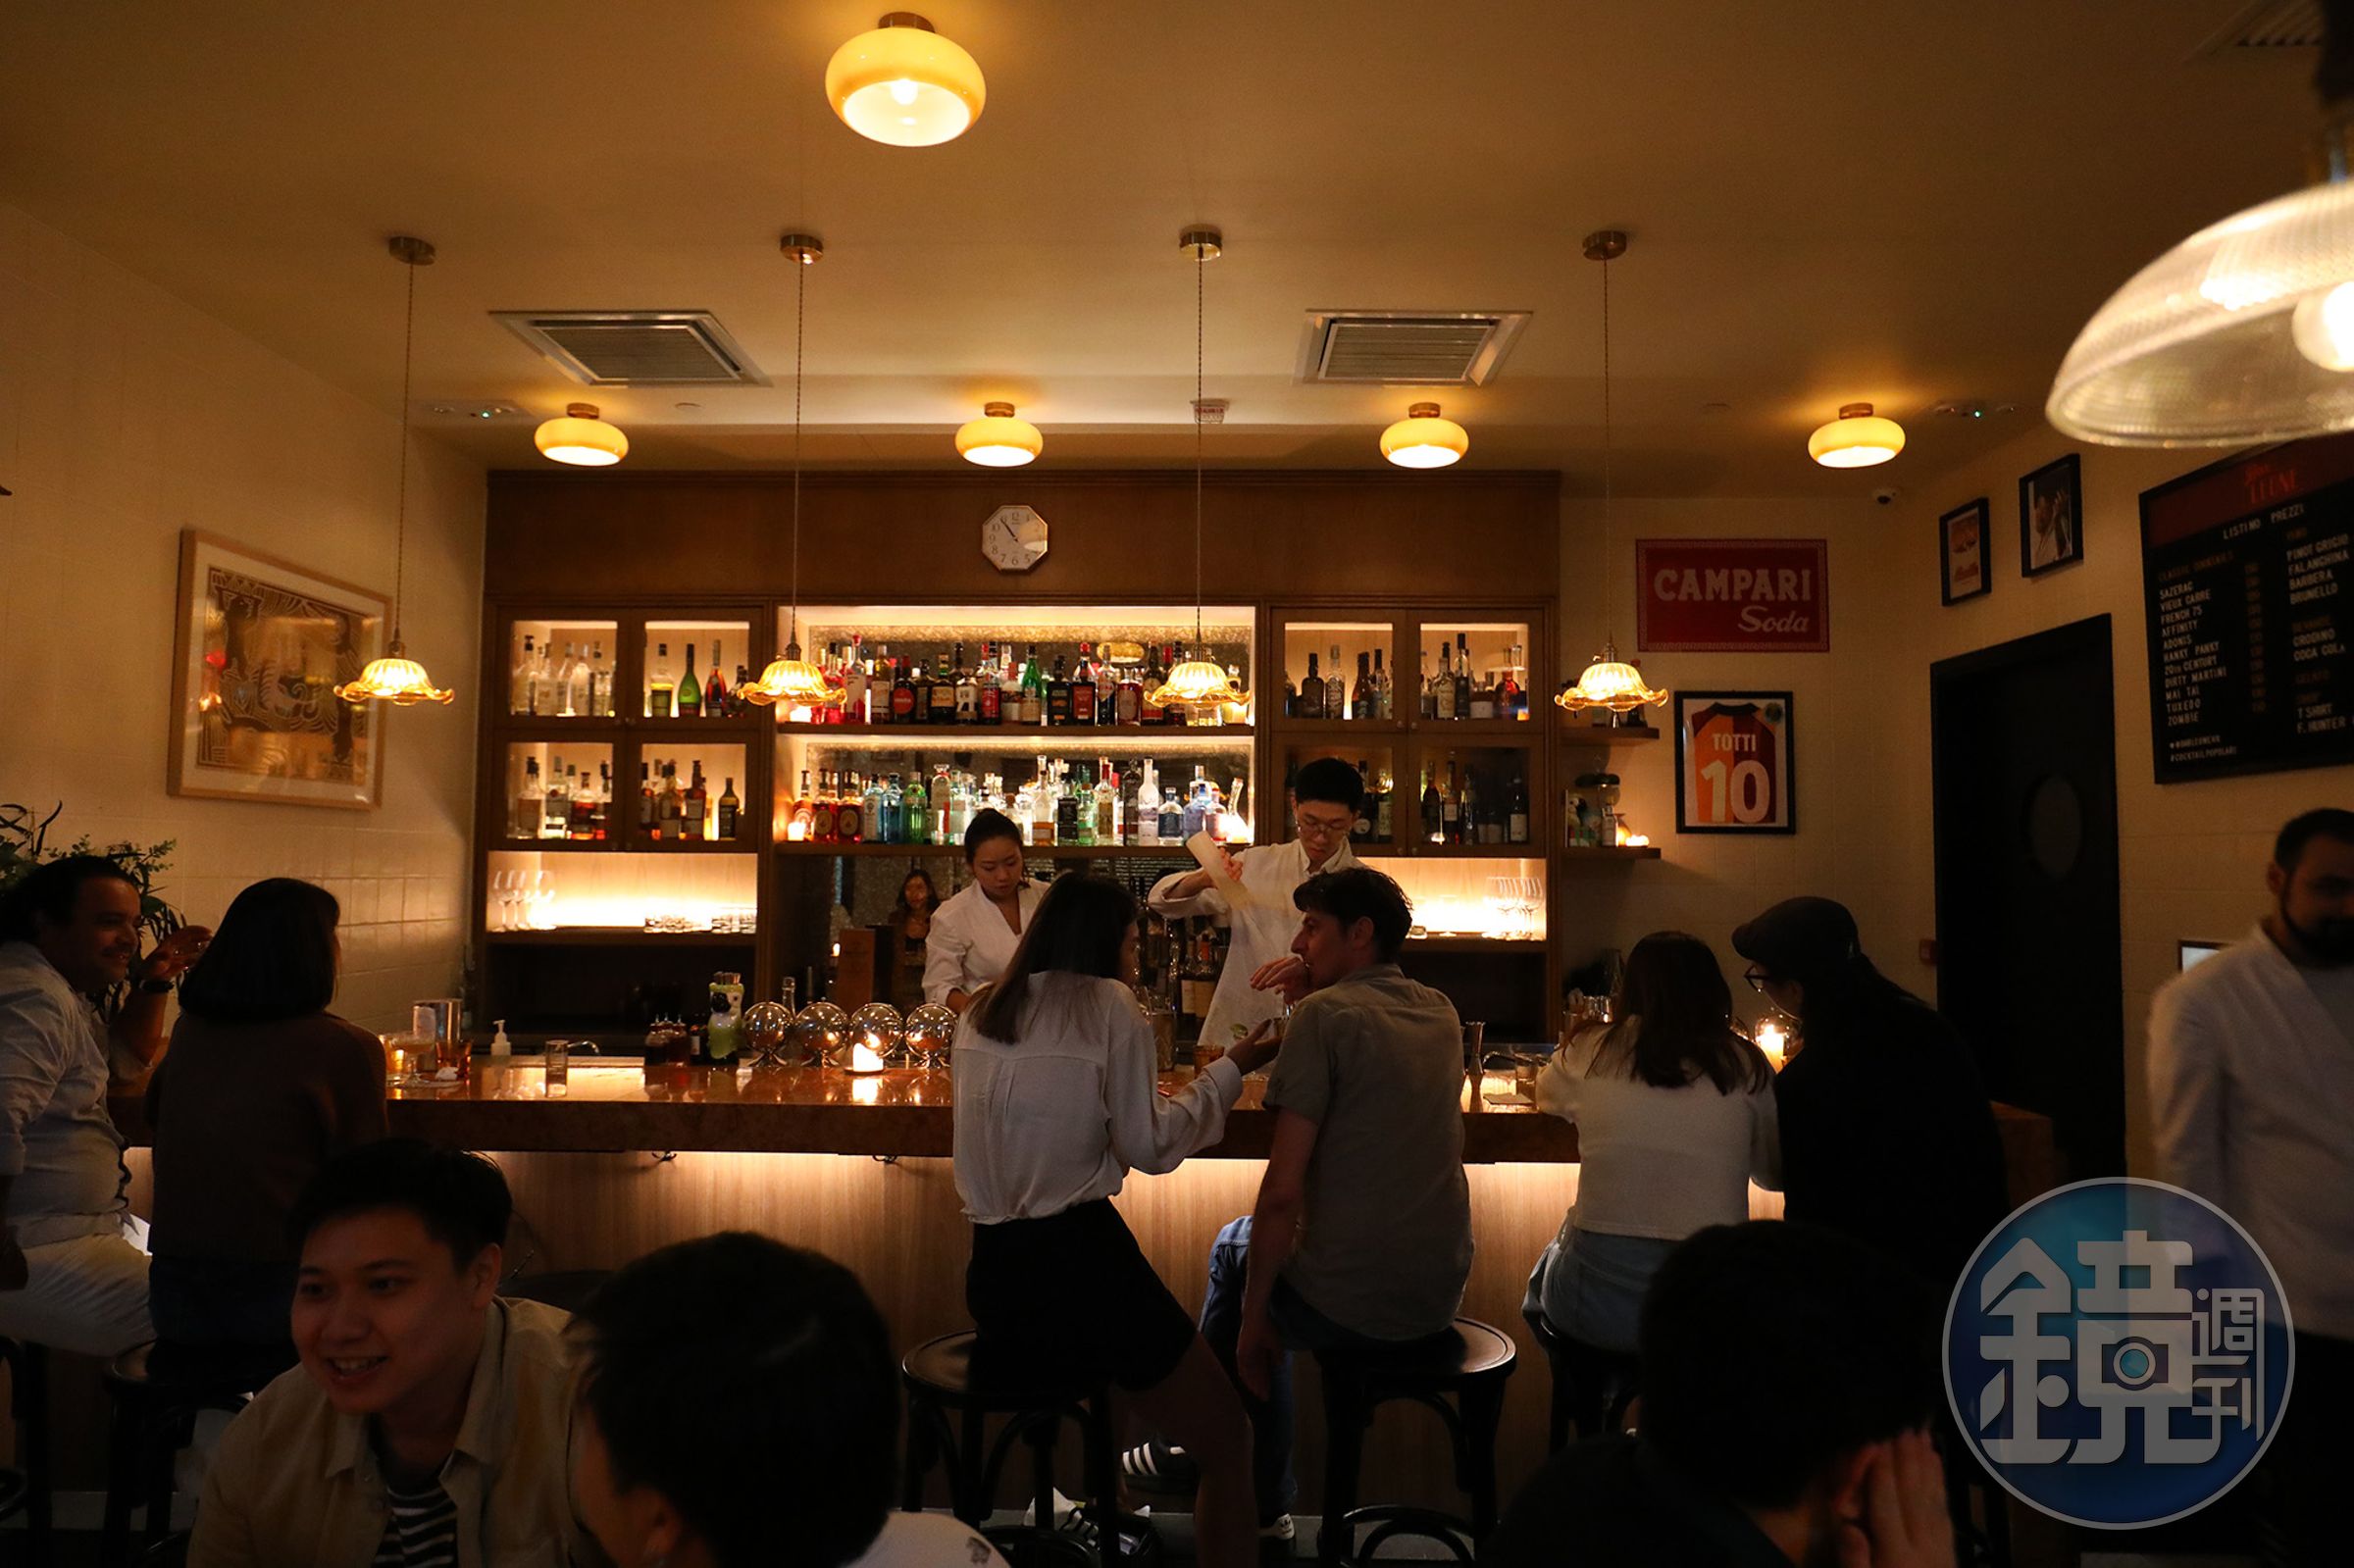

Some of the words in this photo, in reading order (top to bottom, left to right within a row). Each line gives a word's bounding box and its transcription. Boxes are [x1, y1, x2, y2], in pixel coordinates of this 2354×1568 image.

[2271, 503, 2304, 524] PREZZI
[1654, 569, 1812, 602] CAMPARI
[1737, 605, 1810, 632] Soda
[2162, 620, 2198, 637] AFFINITY
[2195, 641, 2220, 656] PANKY
[2293, 647, 2318, 662] COCA
[2191, 667, 2226, 683] MARTINI
[2186, 684, 2200, 697] TAI
[2166, 698, 2201, 714] TUXEDO
[2168, 711, 2199, 728] ZOMBIE
[1712, 733, 1757, 752] TOTTI
[1700, 759, 1770, 824] 10
